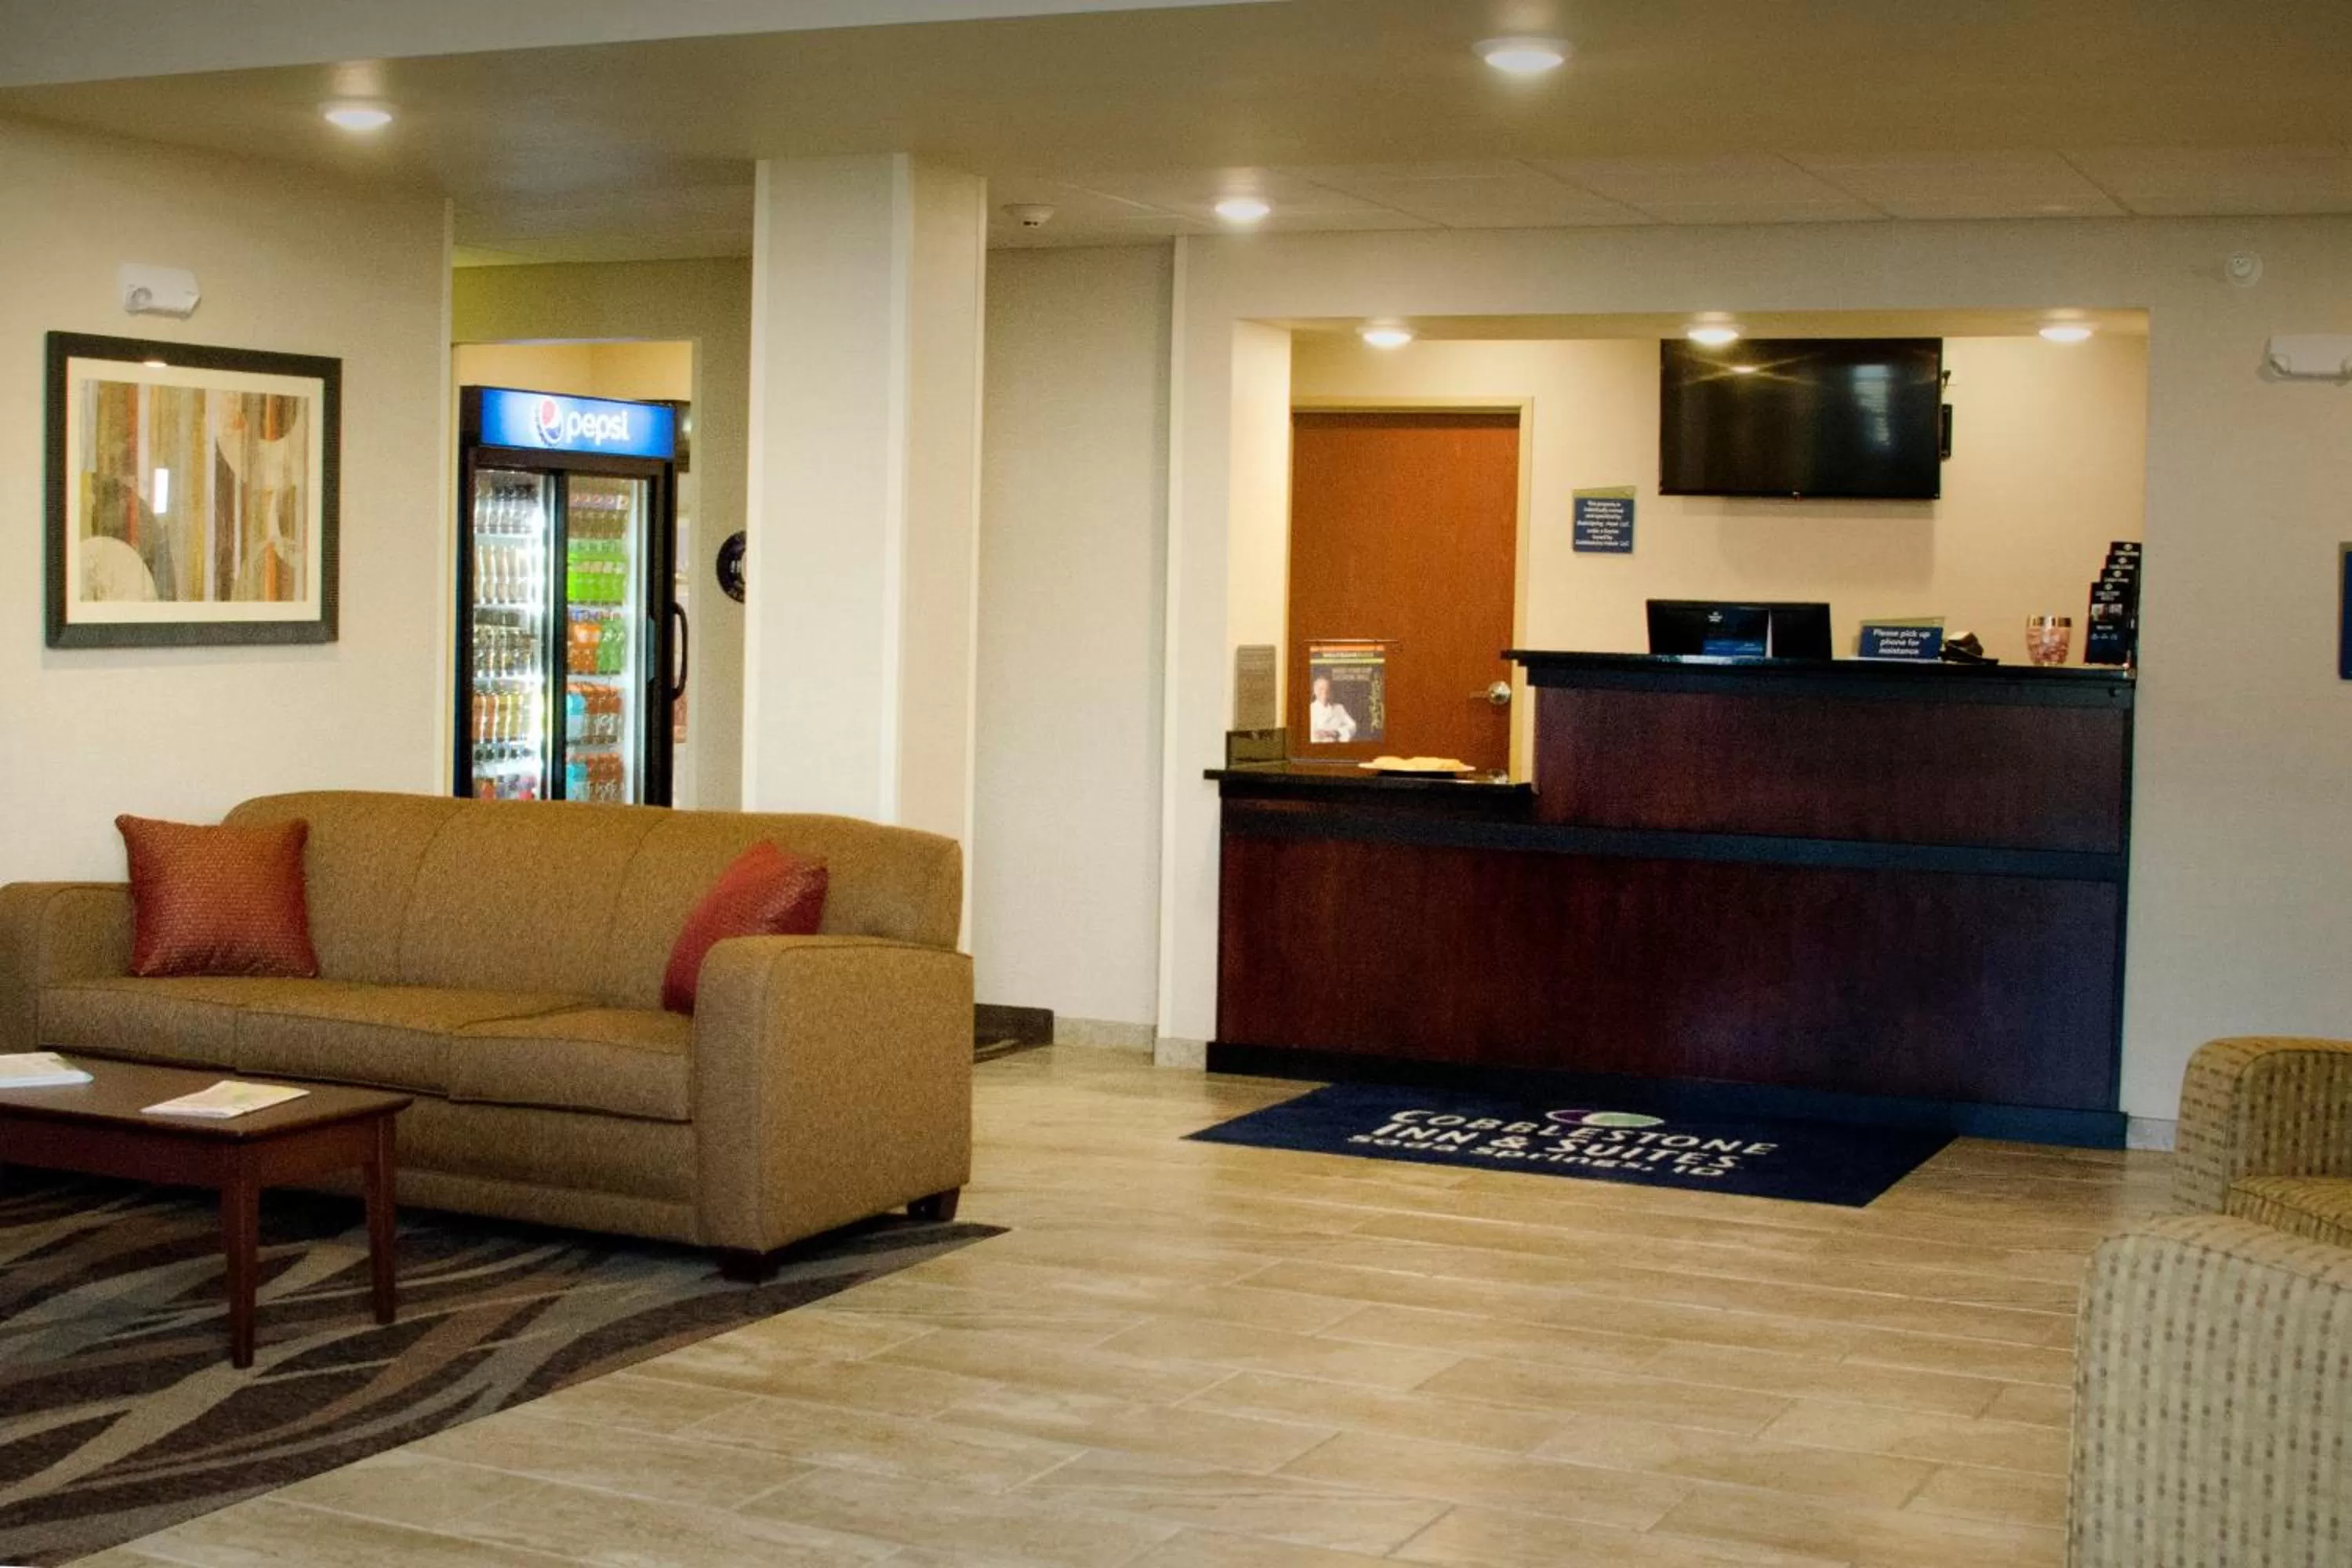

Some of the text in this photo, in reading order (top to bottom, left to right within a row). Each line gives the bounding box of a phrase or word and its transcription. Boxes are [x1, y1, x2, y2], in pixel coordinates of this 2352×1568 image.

[565, 410, 630, 446] pepsi
[1879, 638, 1907, 647] phone
[1900, 630, 1918, 638] pick
[1371, 1122, 1480, 1145] INN
[1490, 1135, 1529, 1149] &
